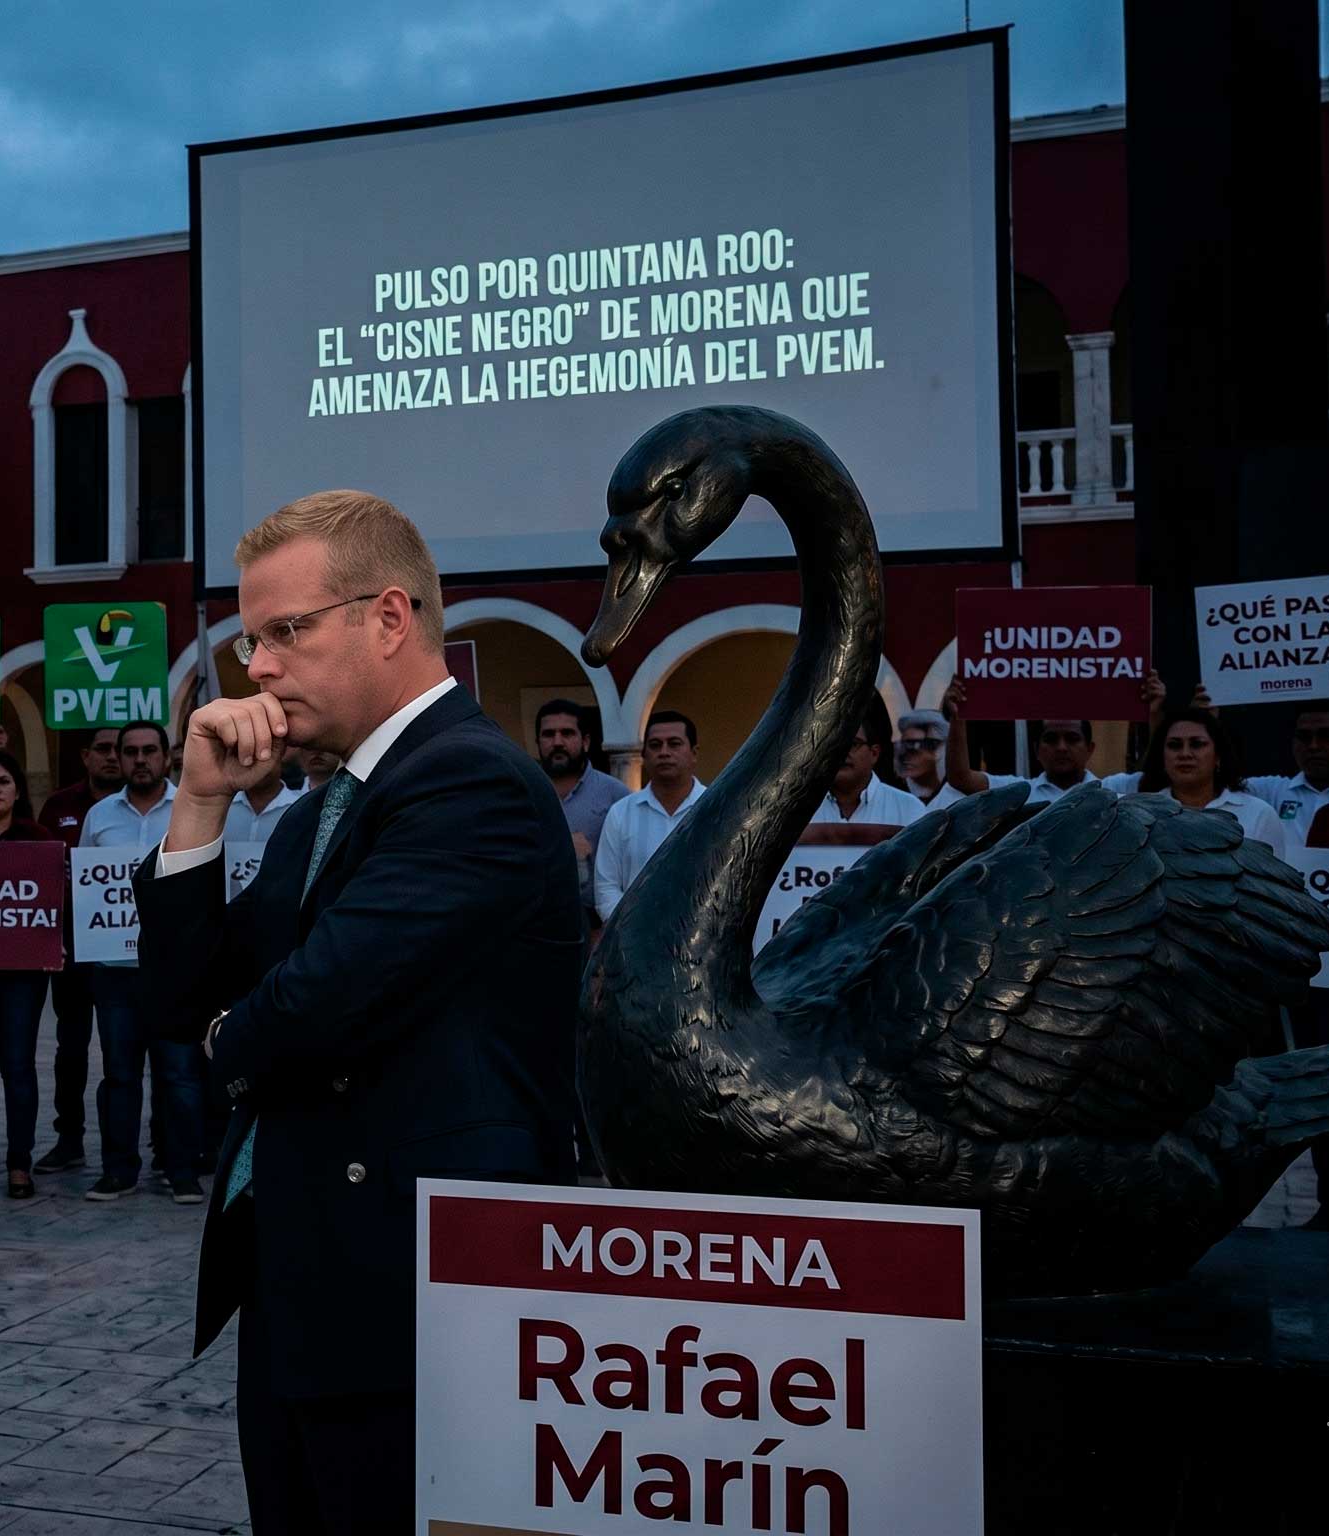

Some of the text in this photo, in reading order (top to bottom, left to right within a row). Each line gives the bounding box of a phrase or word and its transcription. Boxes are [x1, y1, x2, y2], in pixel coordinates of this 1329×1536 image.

[374, 228, 794, 313] PULSO POR QUINTANA ROO:
[318, 272, 870, 368] EL “CISNE NEGRO” DE MORENA QUE
[308, 326, 885, 417] AMENAZA LA HEGEMONÍA DEL PVEM.
[1206, 594, 1278, 628] ¿QUÉ
[1233, 624, 1291, 645] CON
[984, 626, 1121, 654] ¡UNIDAD
[964, 657, 1144, 678] MORENISTA!
[1260, 678, 1313, 691] morena
[53, 687, 162, 722] PVEM
[542, 1223, 841, 1290] MORENA
[518, 1318, 865, 1430] Rafael
[534, 1424, 849, 1536] Marín
